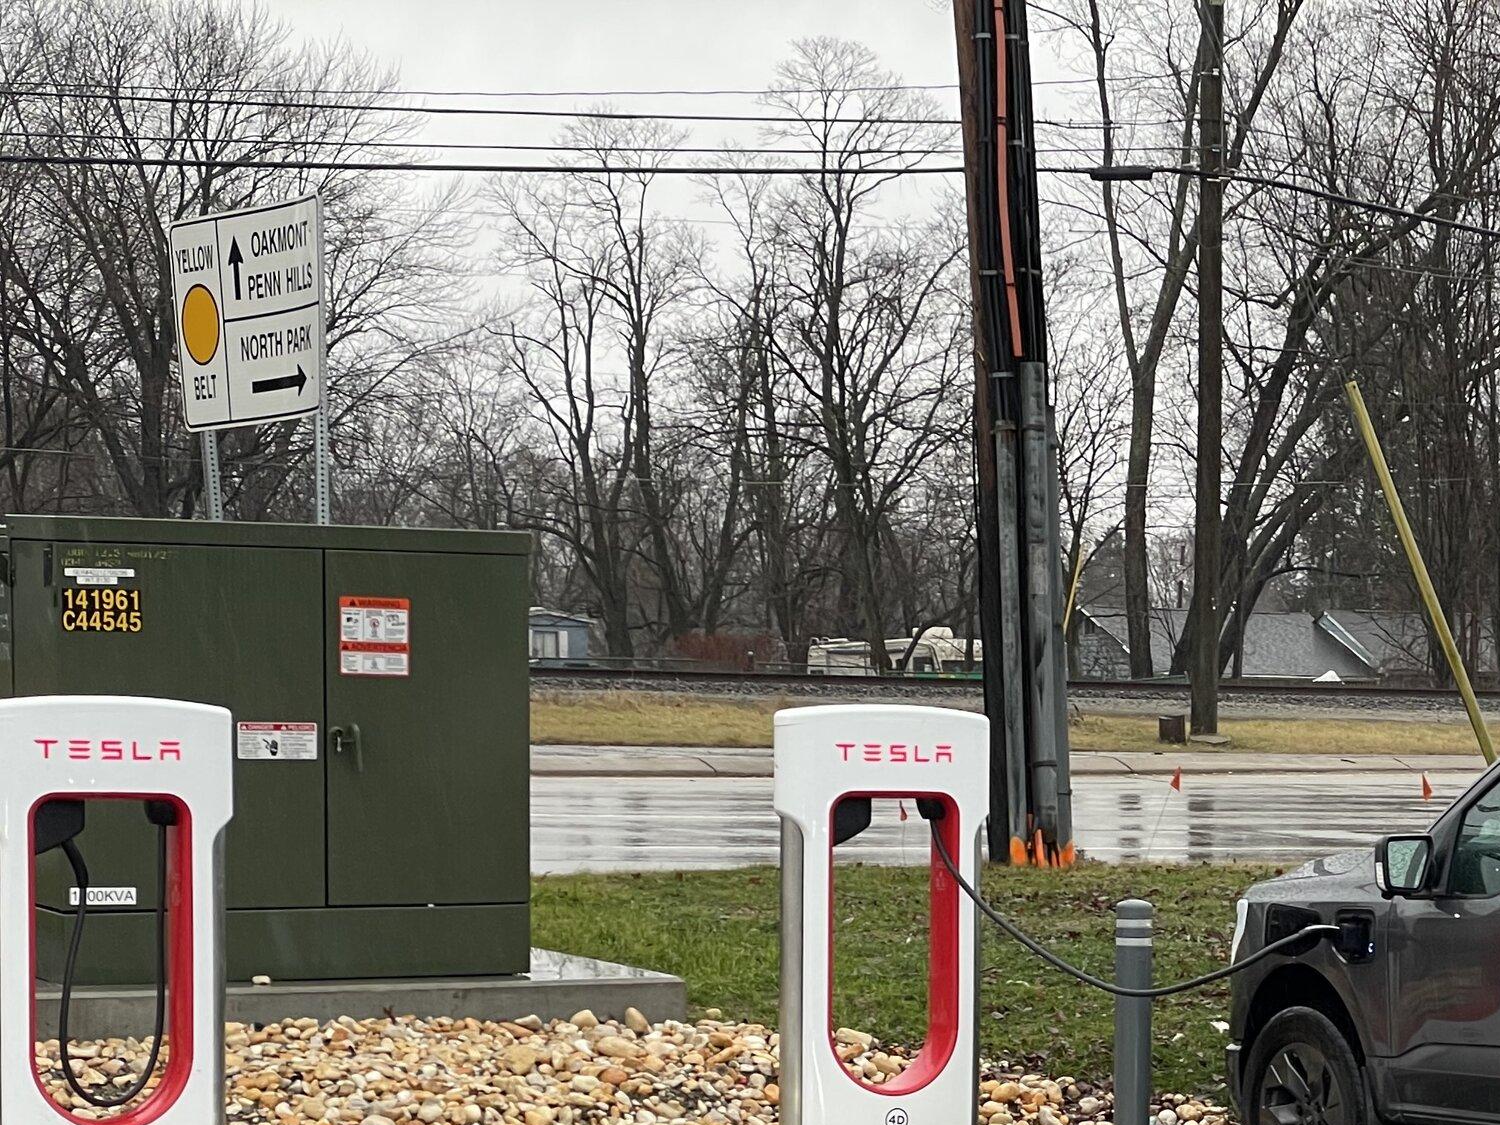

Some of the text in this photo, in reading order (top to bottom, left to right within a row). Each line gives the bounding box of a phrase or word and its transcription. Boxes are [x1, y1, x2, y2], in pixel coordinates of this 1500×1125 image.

[251, 220, 309, 258] OAKMONT
[175, 244, 214, 274] YELLOW
[248, 262, 313, 301] PENN HILLS
[240, 324, 312, 362] NORTH PARK
[194, 374, 217, 401] BELT
[63, 588, 139, 611] 141961
[62, 610, 142, 632] C44545
[34, 739, 181, 761] TESLA
[834, 743, 952, 763] TESLA
[71, 890, 134, 902] 100KVA
[888, 1114, 905, 1125] 4D
